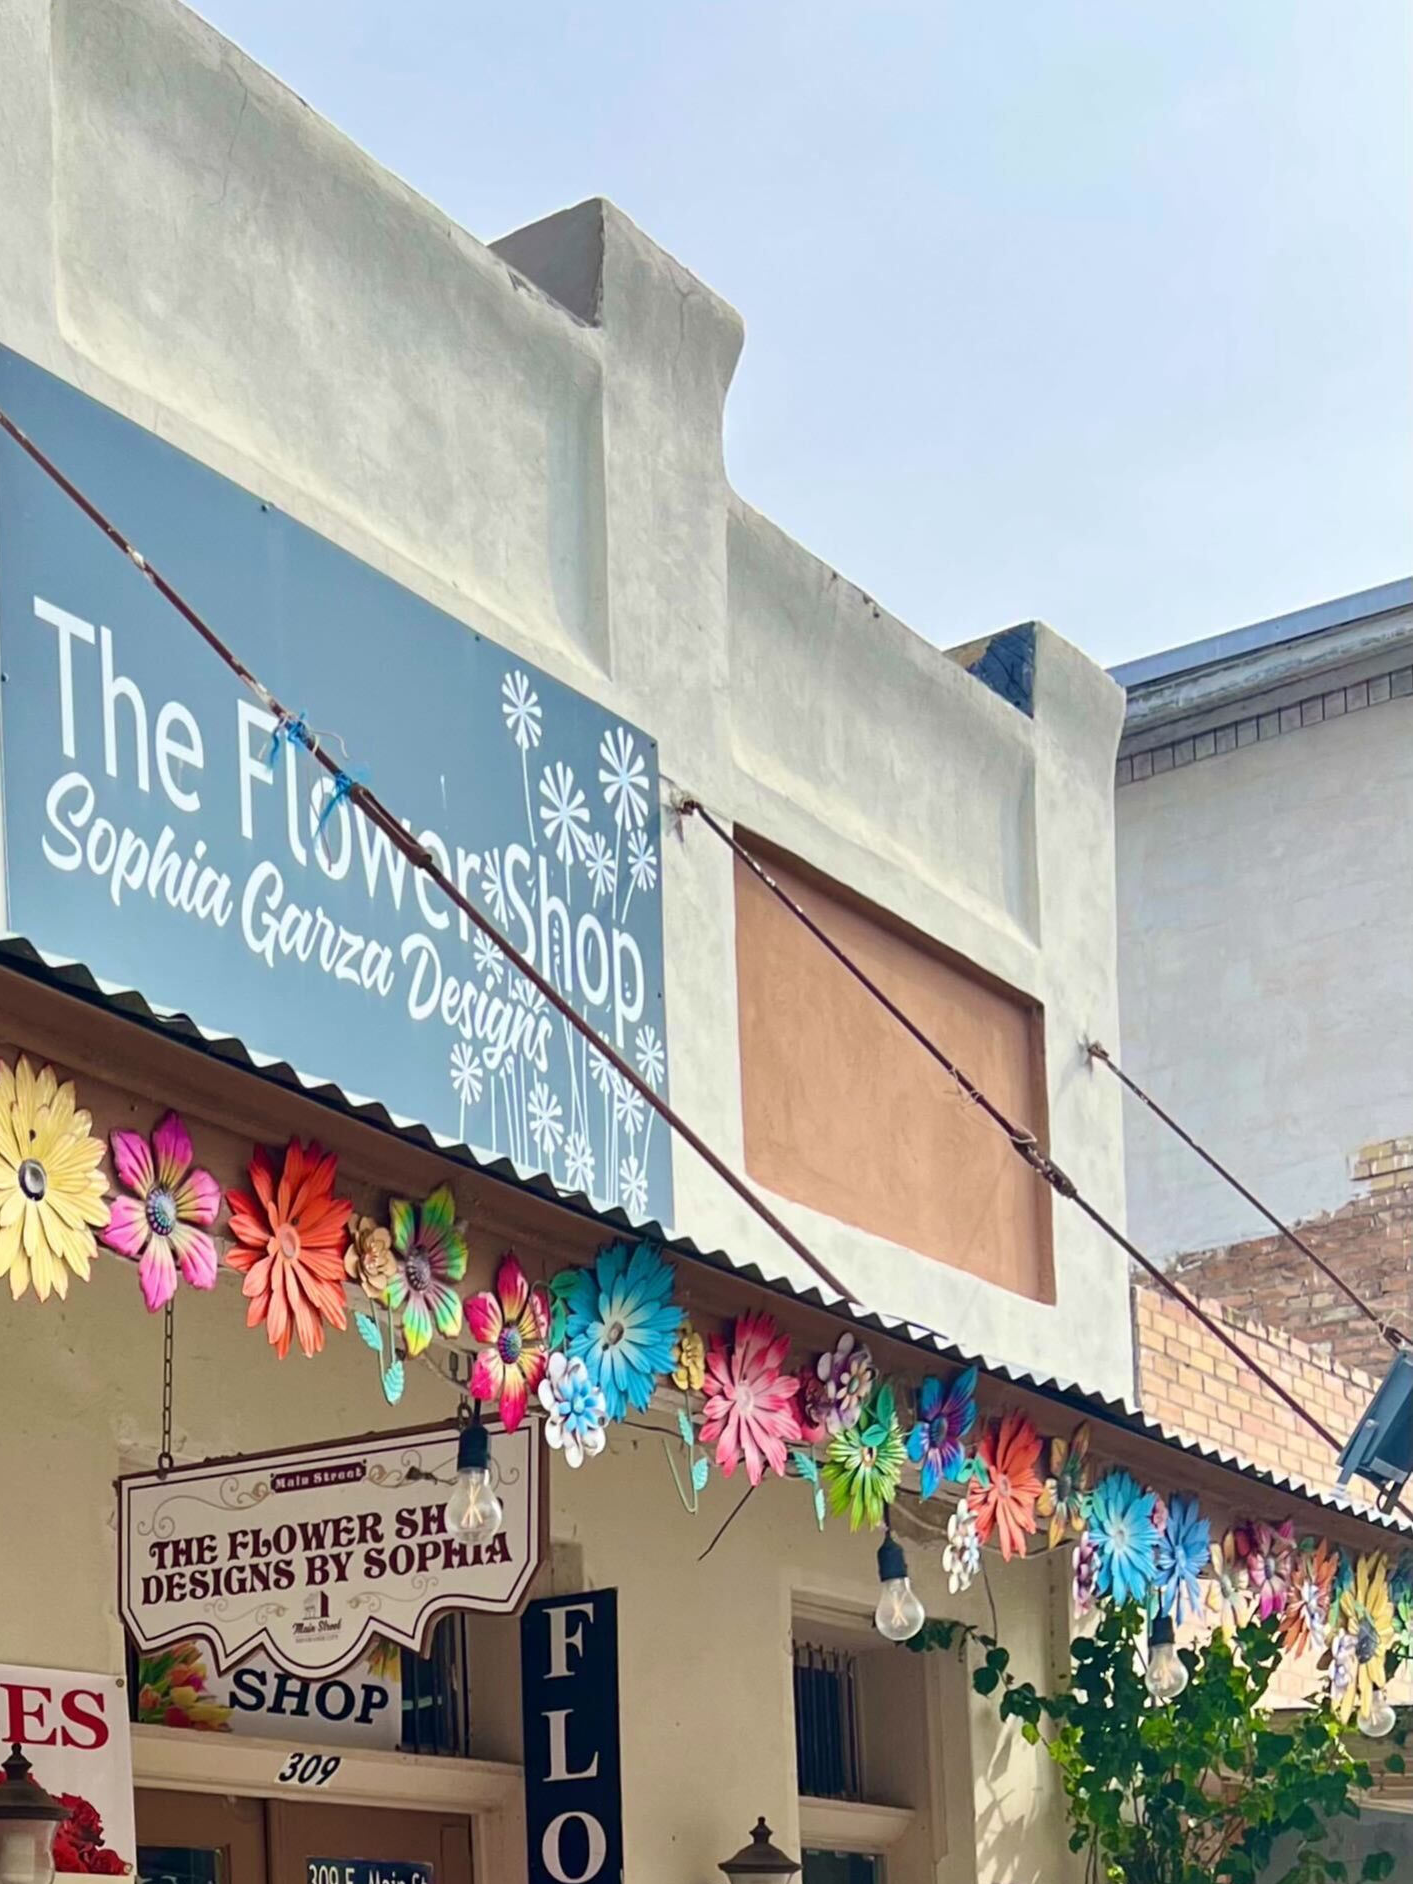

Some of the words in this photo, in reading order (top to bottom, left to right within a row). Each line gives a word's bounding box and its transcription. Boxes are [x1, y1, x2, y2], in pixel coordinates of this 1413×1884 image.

[33, 596, 206, 812] The
[236, 697, 482, 943] Flower
[502, 844, 646, 1050] Shop
[41, 771, 233, 928] Sophia
[241, 860, 395, 996] Garza
[400, 933, 554, 1073] Designs
[275, 1474, 309, 1489] Main
[313, 1467, 363, 1484] Street
[141, 1559, 296, 1606] DESIGNS
[305, 1551, 355, 1586] BY
[363, 1532, 513, 1580] SOPHIA
[148, 1534, 219, 1571] THE
[227, 1511, 385, 1562] FLOWER
[394, 1497, 504, 1539] SH
[228, 1667, 390, 1725] SHOP
[279, 1752, 341, 1786] 309
